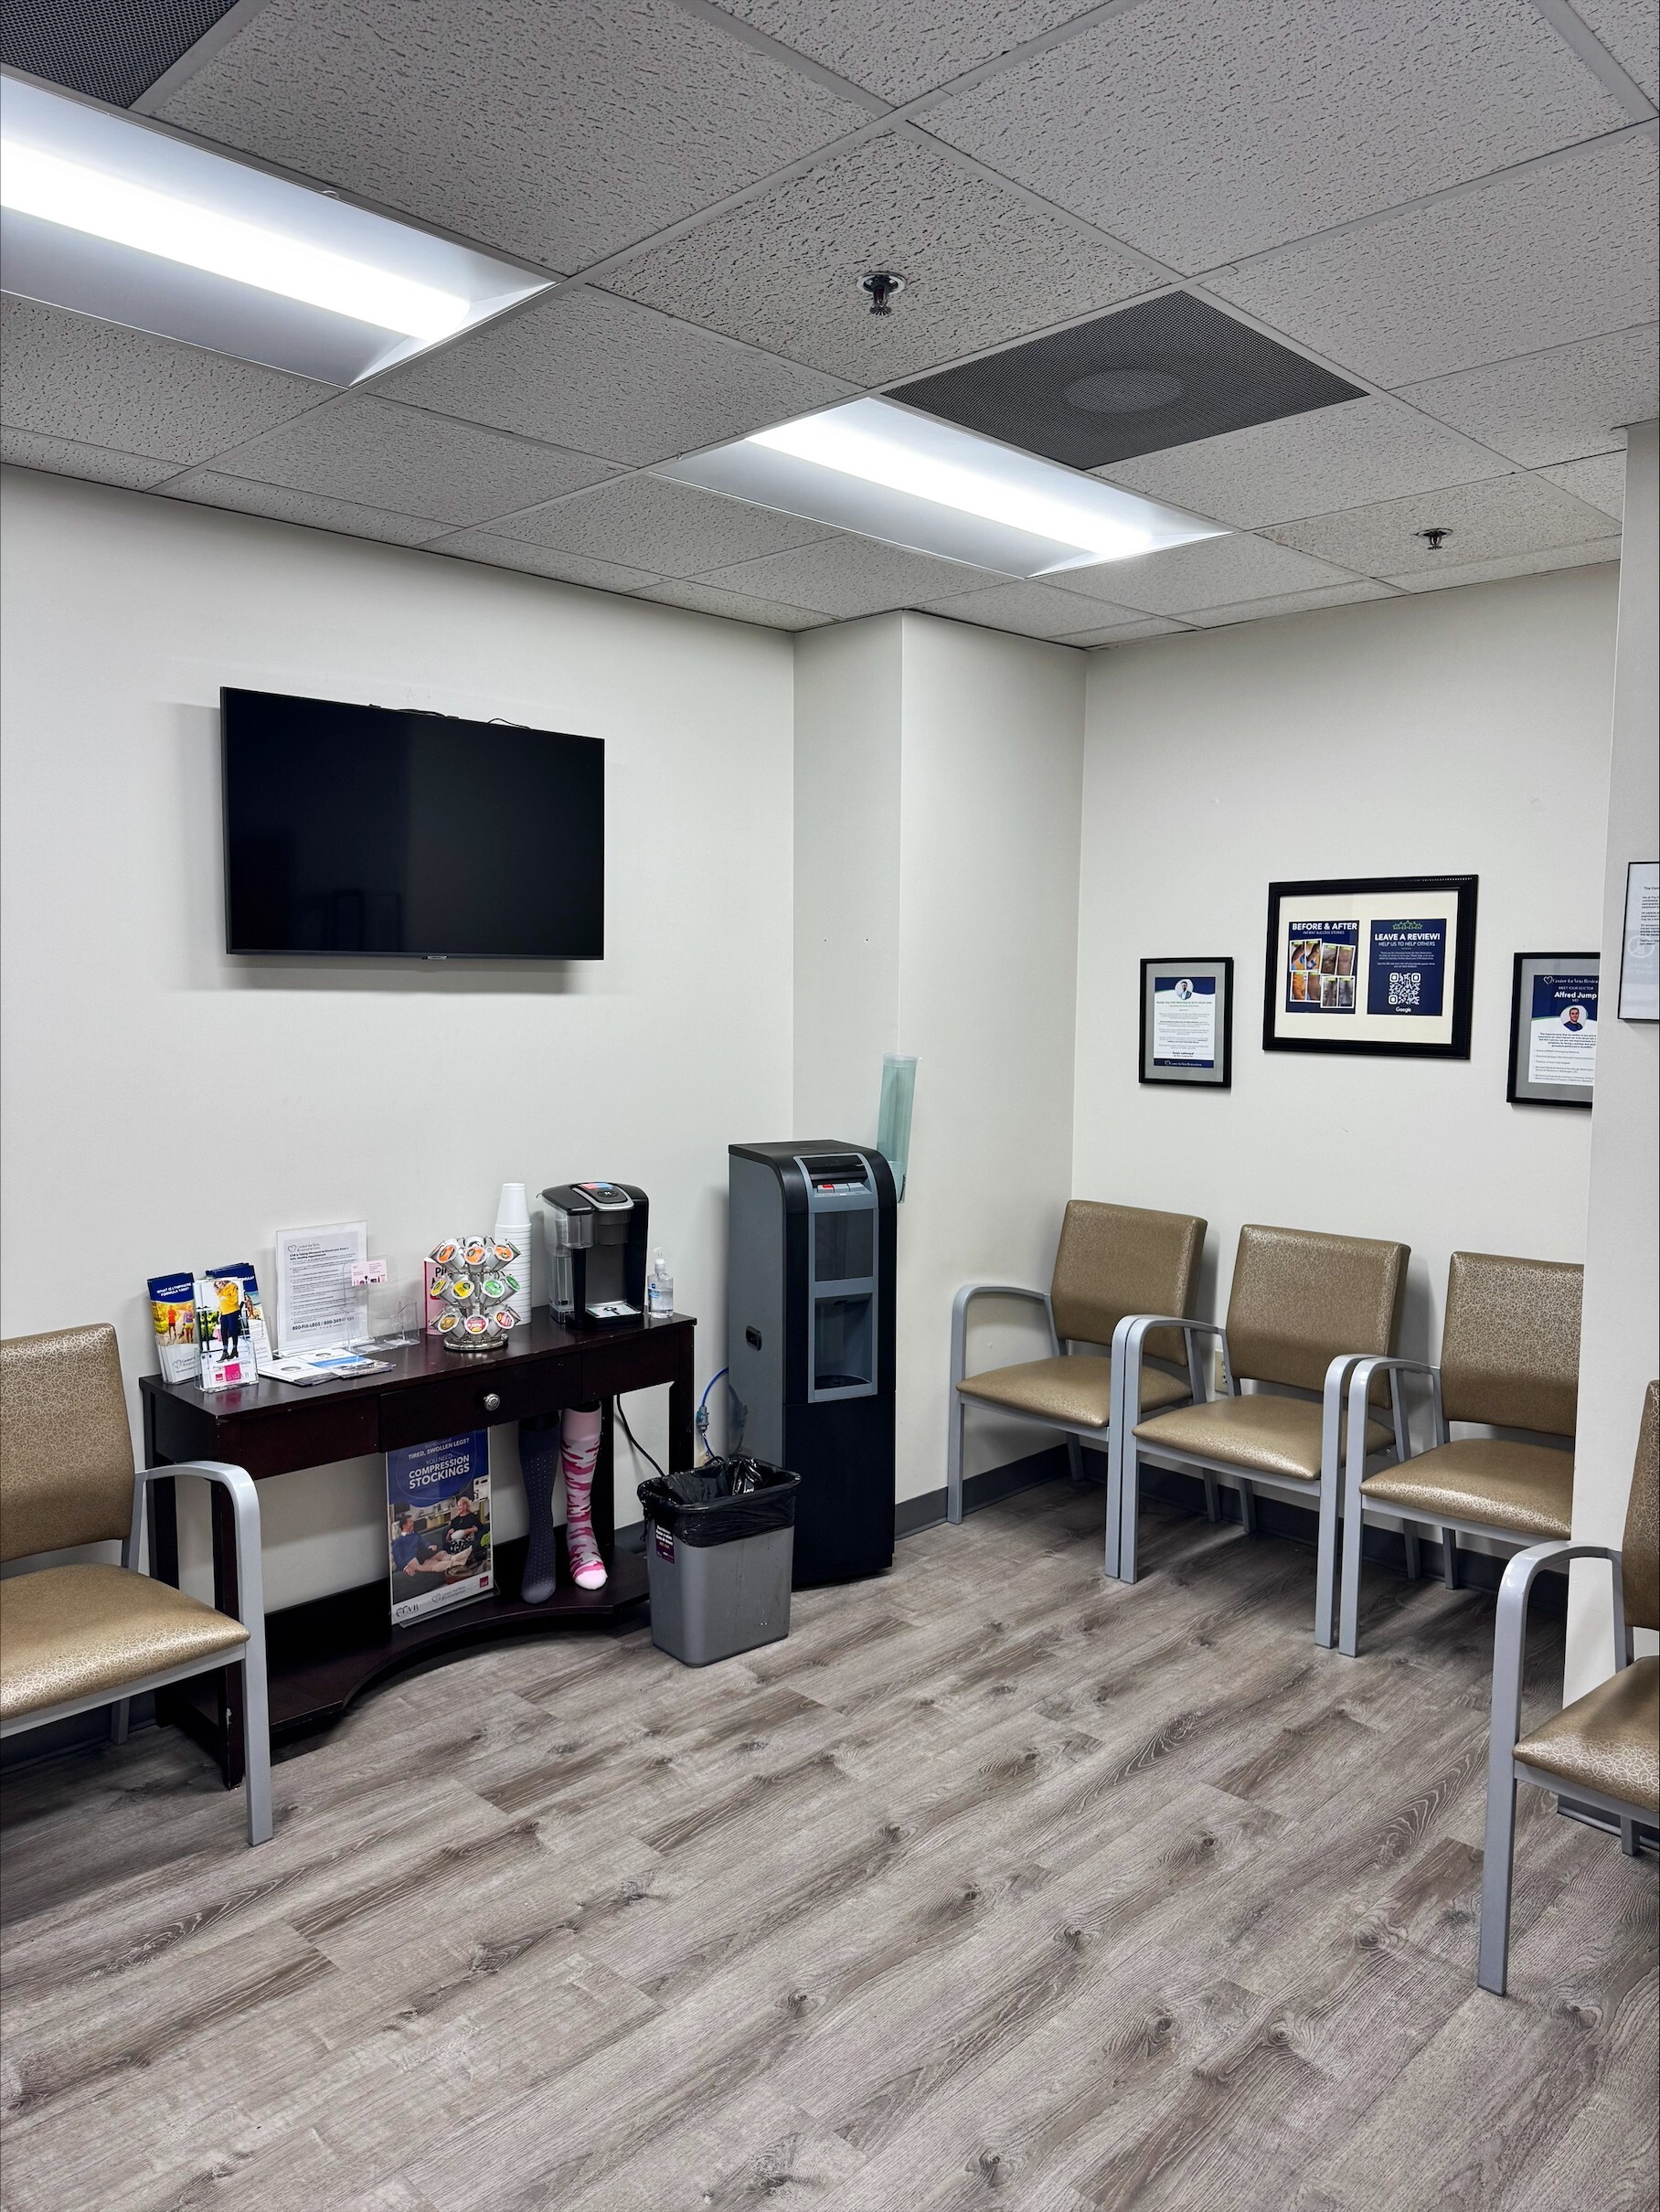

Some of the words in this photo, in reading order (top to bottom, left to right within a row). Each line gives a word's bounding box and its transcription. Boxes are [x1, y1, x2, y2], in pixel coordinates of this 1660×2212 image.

[1577, 992, 1597, 1000] Jump
[408, 1450, 426, 1460] TIRED,
[426, 1443, 453, 1455] SWOLLEN
[454, 1438, 470, 1447] LEGS?
[409, 1454, 470, 1479] COMPRESSION
[409, 1463, 470, 1489] STOCKINGS
